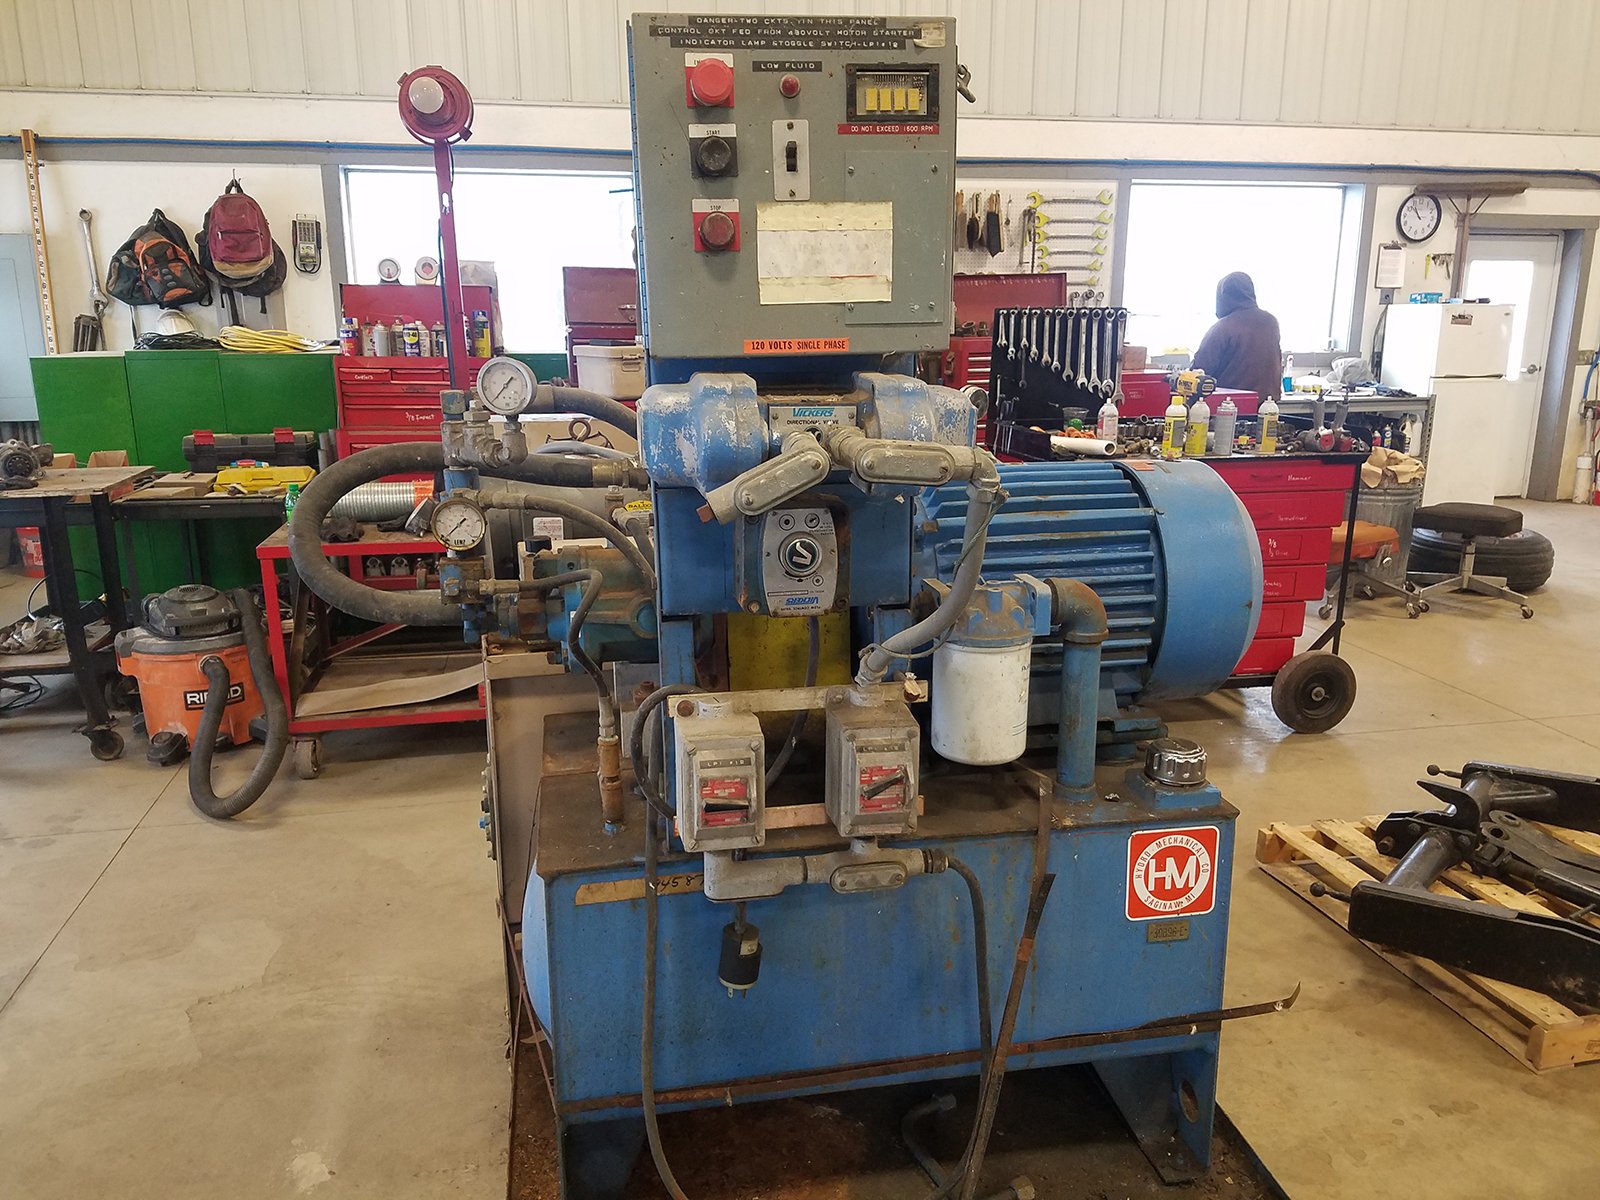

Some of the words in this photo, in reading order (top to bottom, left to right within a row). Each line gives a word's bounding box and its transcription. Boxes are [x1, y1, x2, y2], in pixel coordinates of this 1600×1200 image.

[849, 18, 878, 26] PANEL
[751, 341, 765, 350] 120
[768, 341, 793, 350] VOLTS
[796, 340, 821, 350] SINGLE
[823, 340, 846, 349] PHASE
[792, 407, 835, 417] VICKERS
[785, 596, 819, 606] VICKERS
[186, 686, 242, 705] RID
[1135, 851, 1151, 879] HYDRO
[1155, 836, 1206, 858] MECHANICAL
[1147, 855, 1197, 892] HM
[1185, 892, 1196, 904] MI
